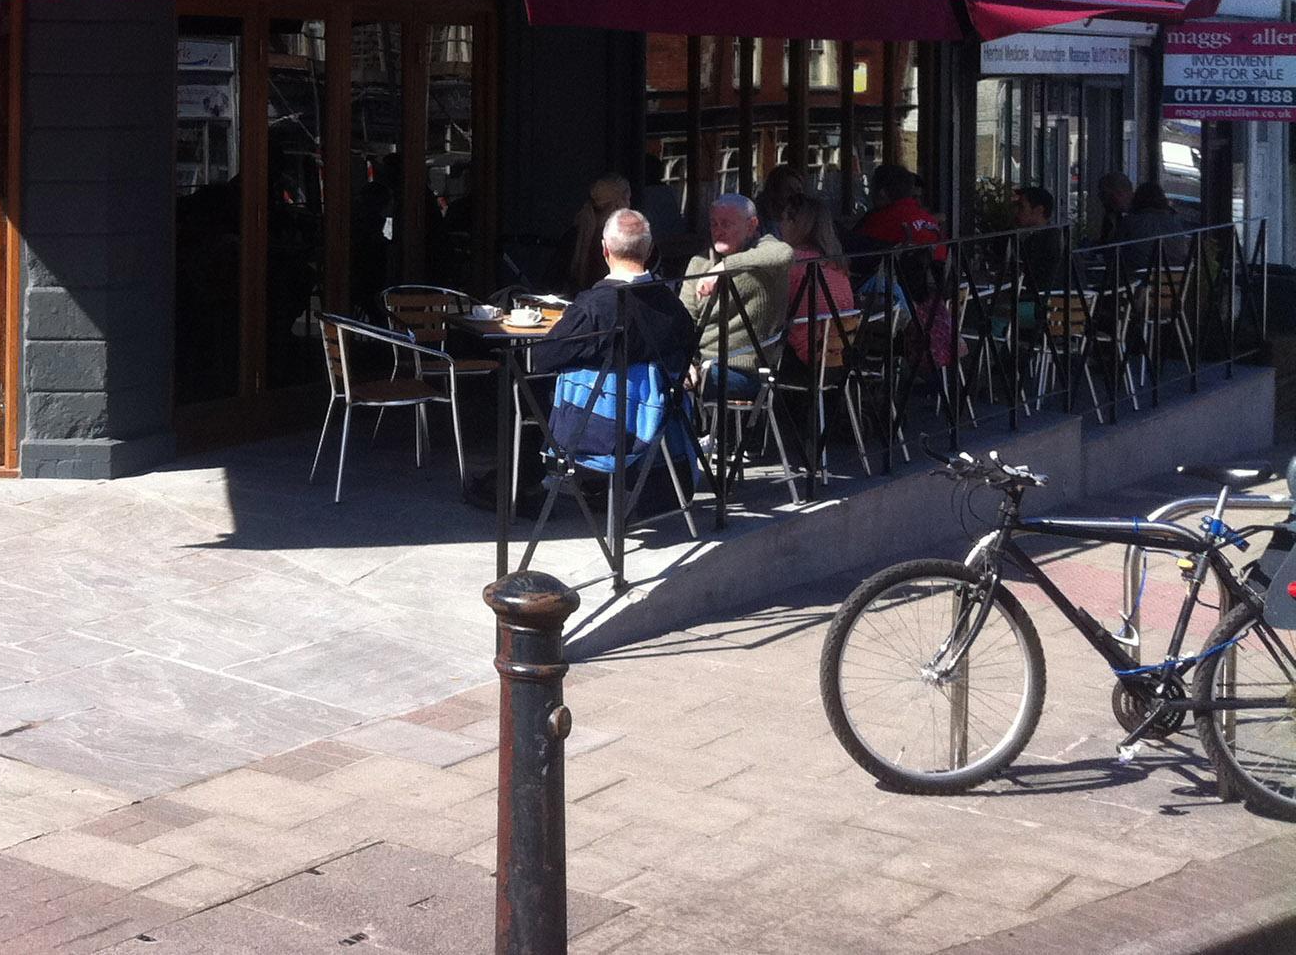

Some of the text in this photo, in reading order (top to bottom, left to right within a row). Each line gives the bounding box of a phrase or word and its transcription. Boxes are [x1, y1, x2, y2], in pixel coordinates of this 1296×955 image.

[1167, 31, 1232, 49] maggs
[1192, 56, 1274, 66] INVESTMENT
[1184, 67, 1284, 81] SHOP FOR SALE
[1174, 89, 1293, 103] 0117 949 1888
[1175, 108, 1292, 118] maggsandallen.co.uk
